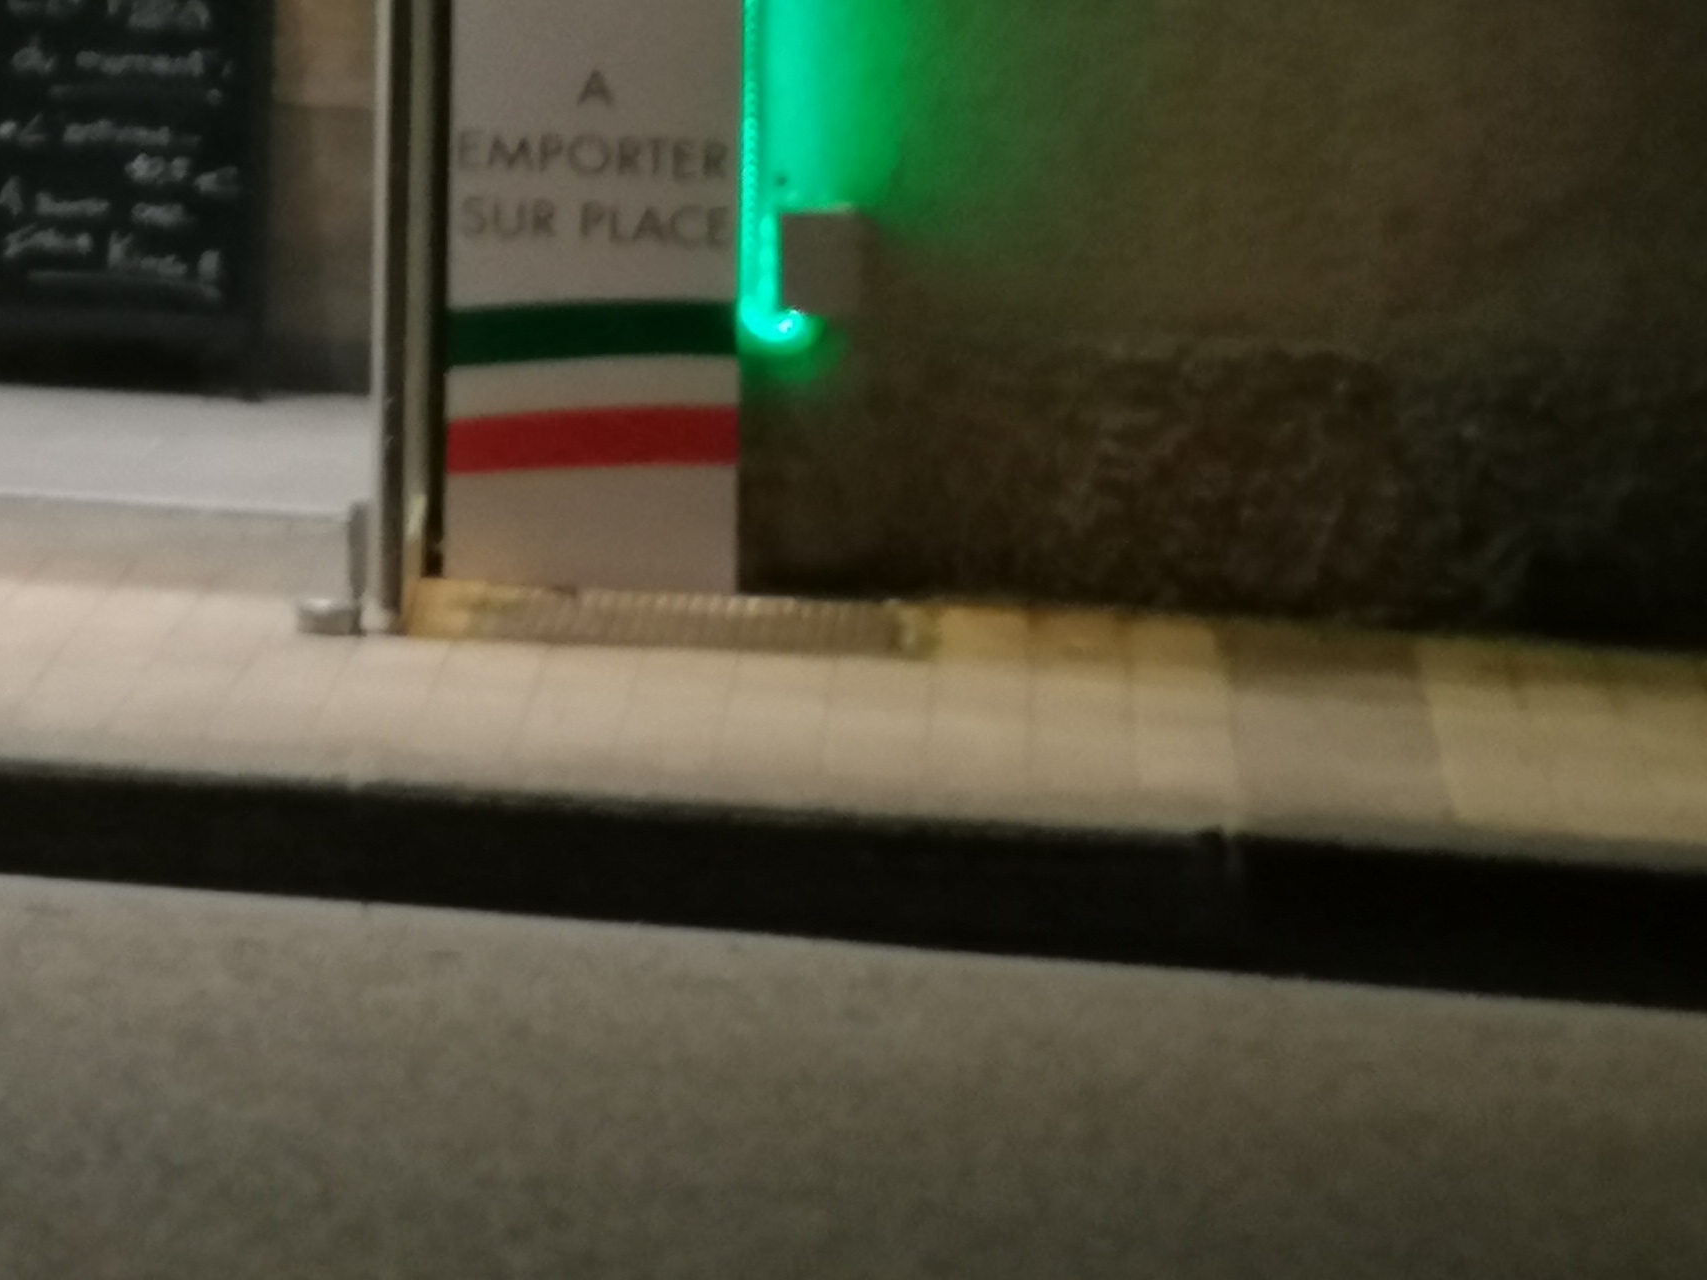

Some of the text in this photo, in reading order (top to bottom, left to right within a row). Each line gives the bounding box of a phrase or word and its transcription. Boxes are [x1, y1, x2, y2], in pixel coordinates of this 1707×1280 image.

[576, 68, 615, 107] A
[456, 130, 729, 180] EMPORTER
[461, 196, 729, 247] SUR PLACE
